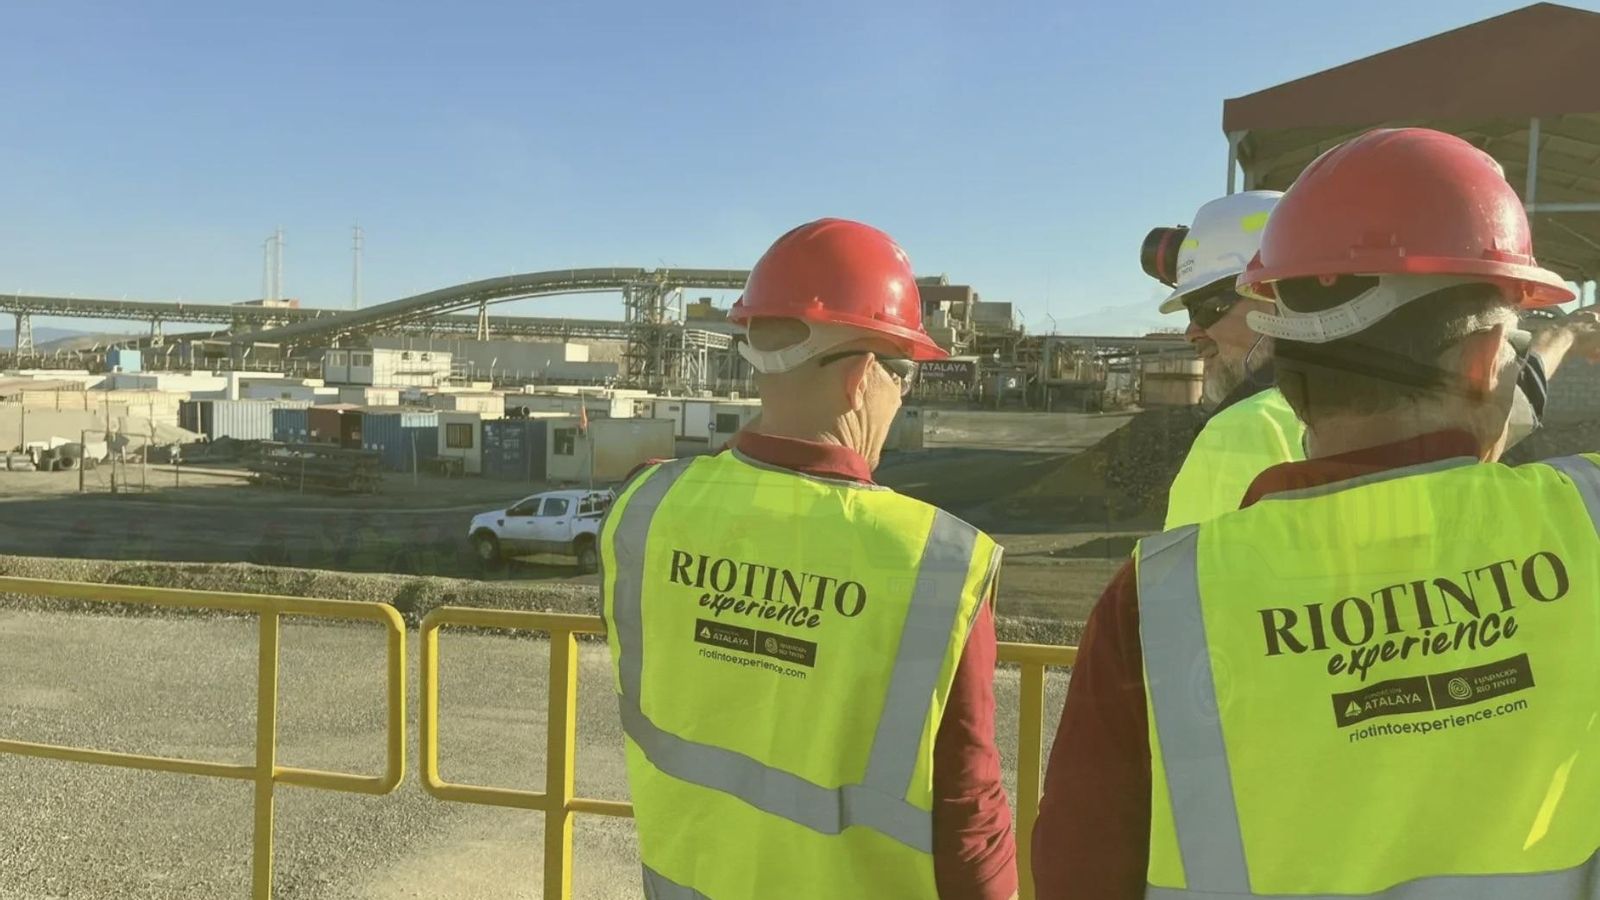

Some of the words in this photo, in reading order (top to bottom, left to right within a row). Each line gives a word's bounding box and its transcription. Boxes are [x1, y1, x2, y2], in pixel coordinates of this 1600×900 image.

[921, 362, 967, 372] ATALAYA
[669, 549, 867, 618] RIOTINTO
[698, 592, 821, 629] experience
[1257, 551, 1569, 657] RIOTINTO
[712, 632, 749, 646] ATALAYA
[1327, 612, 1519, 682] experience
[698, 648, 807, 680] riotintoexperience.com
[1364, 692, 1422, 711] ATALAYA
[1349, 699, 1528, 743] riotintoexperience.com
